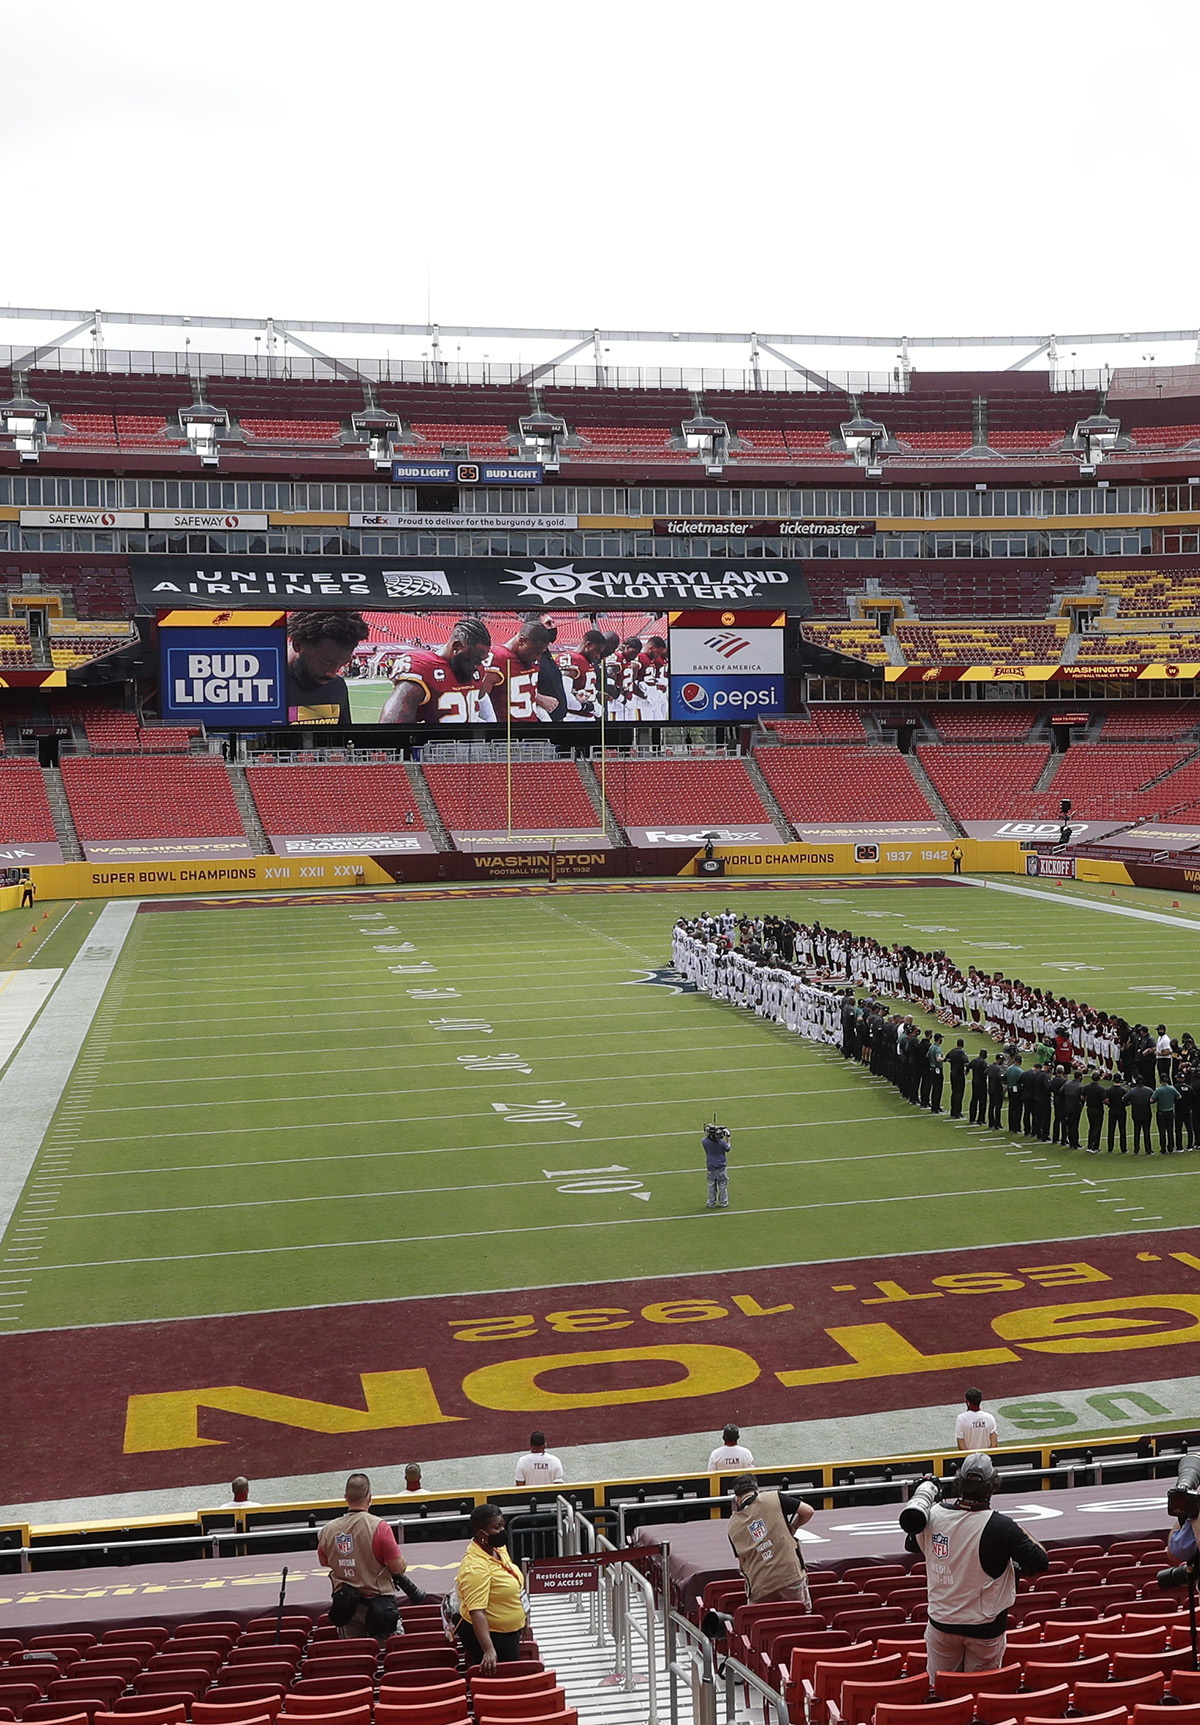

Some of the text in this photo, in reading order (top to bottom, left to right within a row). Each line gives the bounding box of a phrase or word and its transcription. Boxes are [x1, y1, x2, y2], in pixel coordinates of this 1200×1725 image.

[398, 468, 450, 477] BUD LIGHT
[460, 467, 475, 479] 25
[486, 469, 538, 479] BUD LIGHT
[48, 514, 100, 524] SAFEWAY
[174, 516, 224, 526] SAFEWAY
[362, 516, 389, 525] FedEx
[398, 517, 423, 526] Proud
[424, 517, 434, 525] to
[435, 517, 464, 526] deliver
[465, 517, 479, 526] for
[481, 518, 494, 526] the
[495, 518, 536, 528] burgundy
[545, 519, 567, 528] gold.
[667, 520, 750, 535] ticketmaster
[779, 522, 861, 535] ticketmaster
[196, 570, 368, 582] UNITED
[601, 571, 789, 585] MARYLAND
[152, 581, 371, 594] AIRLINES
[607, 584, 758, 599] LOTTERY
[188, 654, 259, 679] BUD
[1063, 666, 1138, 675] WASHINGTON
[175, 679, 270, 703] LIGHT
[713, 686, 775, 710] pepsi
[802, 827, 942, 836] WASHINGTON
[89, 843, 249, 853] WASHINGTON
[858, 846, 876, 860] 25
[474, 854, 606, 868] WASHINGTON
[720, 853, 835, 866] WORLD CHAMPIONS
[886, 851, 913, 862] 1937
[920, 850, 948, 861] 1942
[264, 867, 290, 879] XVII
[299, 866, 325, 878] XXII
[1039, 859, 1070, 875] KICKOFF
[92, 868, 256, 885] SUPER BOWL CHAMPIONS
[456, 1053, 527, 1072] 30
[491, 1099, 578, 1123] 20
[542, 1164, 644, 1194] 10
[834, 1261, 1113, 1305] EST.
[448, 1294, 796, 1343] 1932
[1001, 1391, 1171, 1429] US
[972, 1421, 986, 1429] TEAM
[533, 1462, 549, 1470] TEAM
[725, 1457, 740, 1465] TEAM
[752, 1527, 766, 1539] NFL
[337, 1541, 352, 1552] NFL
[932, 1545, 948, 1558] NFL
[761, 1550, 774, 1561] 102
[338, 1558, 355, 1568] MEDIA
[535, 1571, 593, 1582] Restricted Area
[543, 1579, 584, 1588] NO ACCESS
